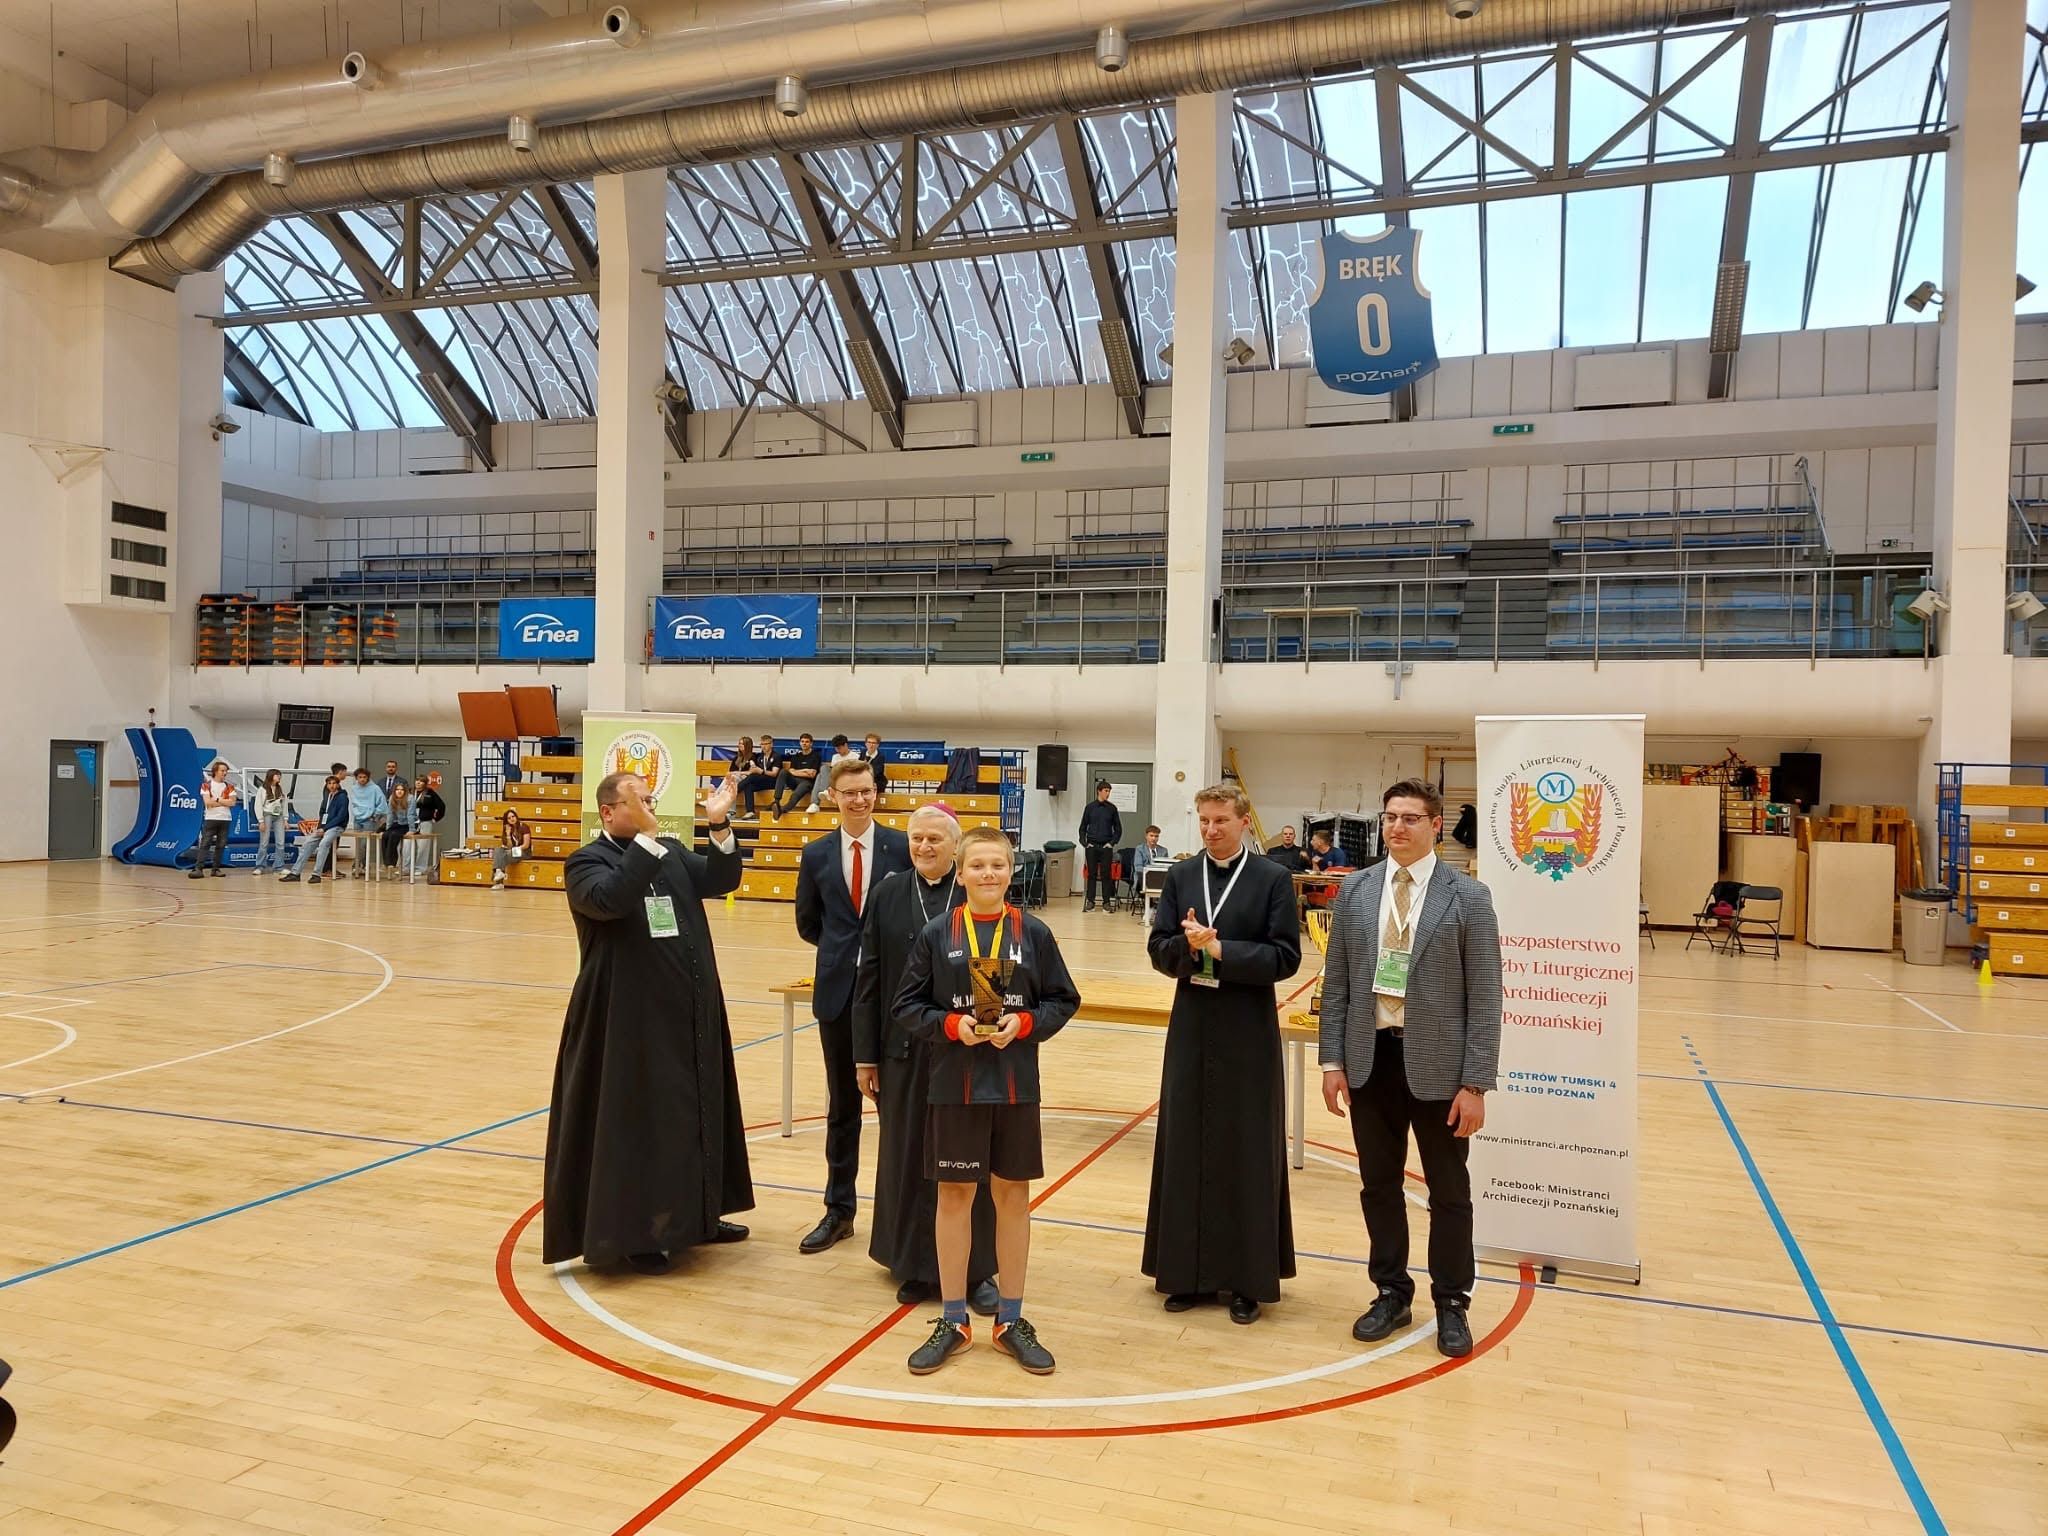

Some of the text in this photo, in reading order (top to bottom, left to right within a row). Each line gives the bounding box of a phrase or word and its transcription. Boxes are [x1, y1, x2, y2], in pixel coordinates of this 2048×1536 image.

[1339, 254, 1402, 282] BRĘK
[1356, 292, 1391, 356] 0
[522, 625, 579, 643] Enea
[674, 624, 725, 640] Enea
[750, 624, 802, 640] Enea
[1520, 753, 1583, 771] Liturgicznej
[1545, 778, 1567, 797] M
[1584, 764, 1625, 820] Archidiecezji
[169, 793, 197, 809] Enea
[1489, 802, 1519, 872] Duszpasterstwo
[1587, 824, 1627, 877] Poznańskiej
[1500, 934, 1621, 953] uszpasterstwo
[1501, 959, 1634, 984] żby Liturgicznej
[1503, 1011, 1603, 1036] Poznańskiej
[1508, 1071, 1617, 1089] OSTRÓW TUMSKI 4
[1507, 1084, 1595, 1100] 61-109 POZNAŃ
[1475, 1133, 1629, 1159] www.ministranci.archpoznan.pl
[938, 1160, 980, 1169] GIVOVA
[1491, 1177, 1610, 1201] Facebook: Ministranci
[1482, 1190, 1620, 1218] Archidiecezji Poznańskiej
